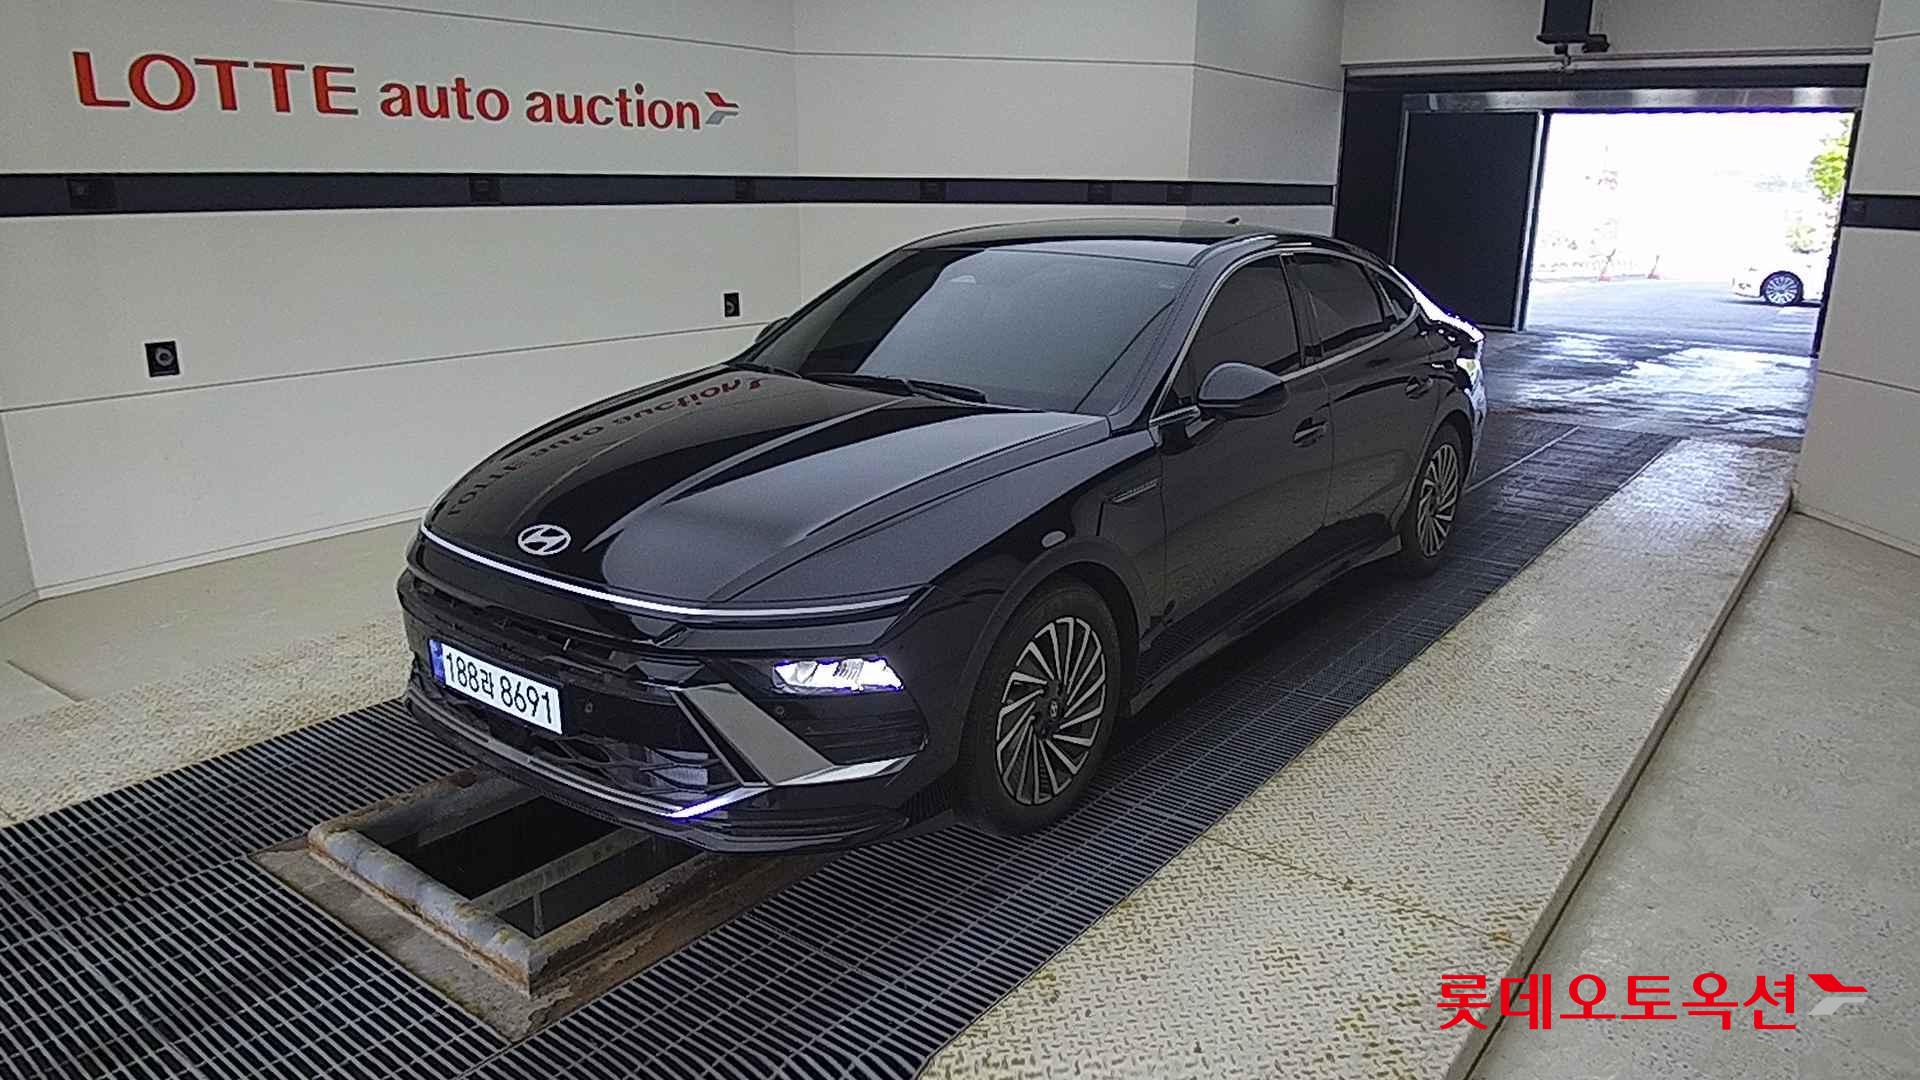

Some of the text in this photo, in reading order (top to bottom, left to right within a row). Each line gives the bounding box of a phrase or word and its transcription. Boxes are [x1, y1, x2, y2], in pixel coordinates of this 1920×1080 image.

[73, 51, 702, 131] LOTTE auto auction
[445, 652, 552, 725] 188라 8691
